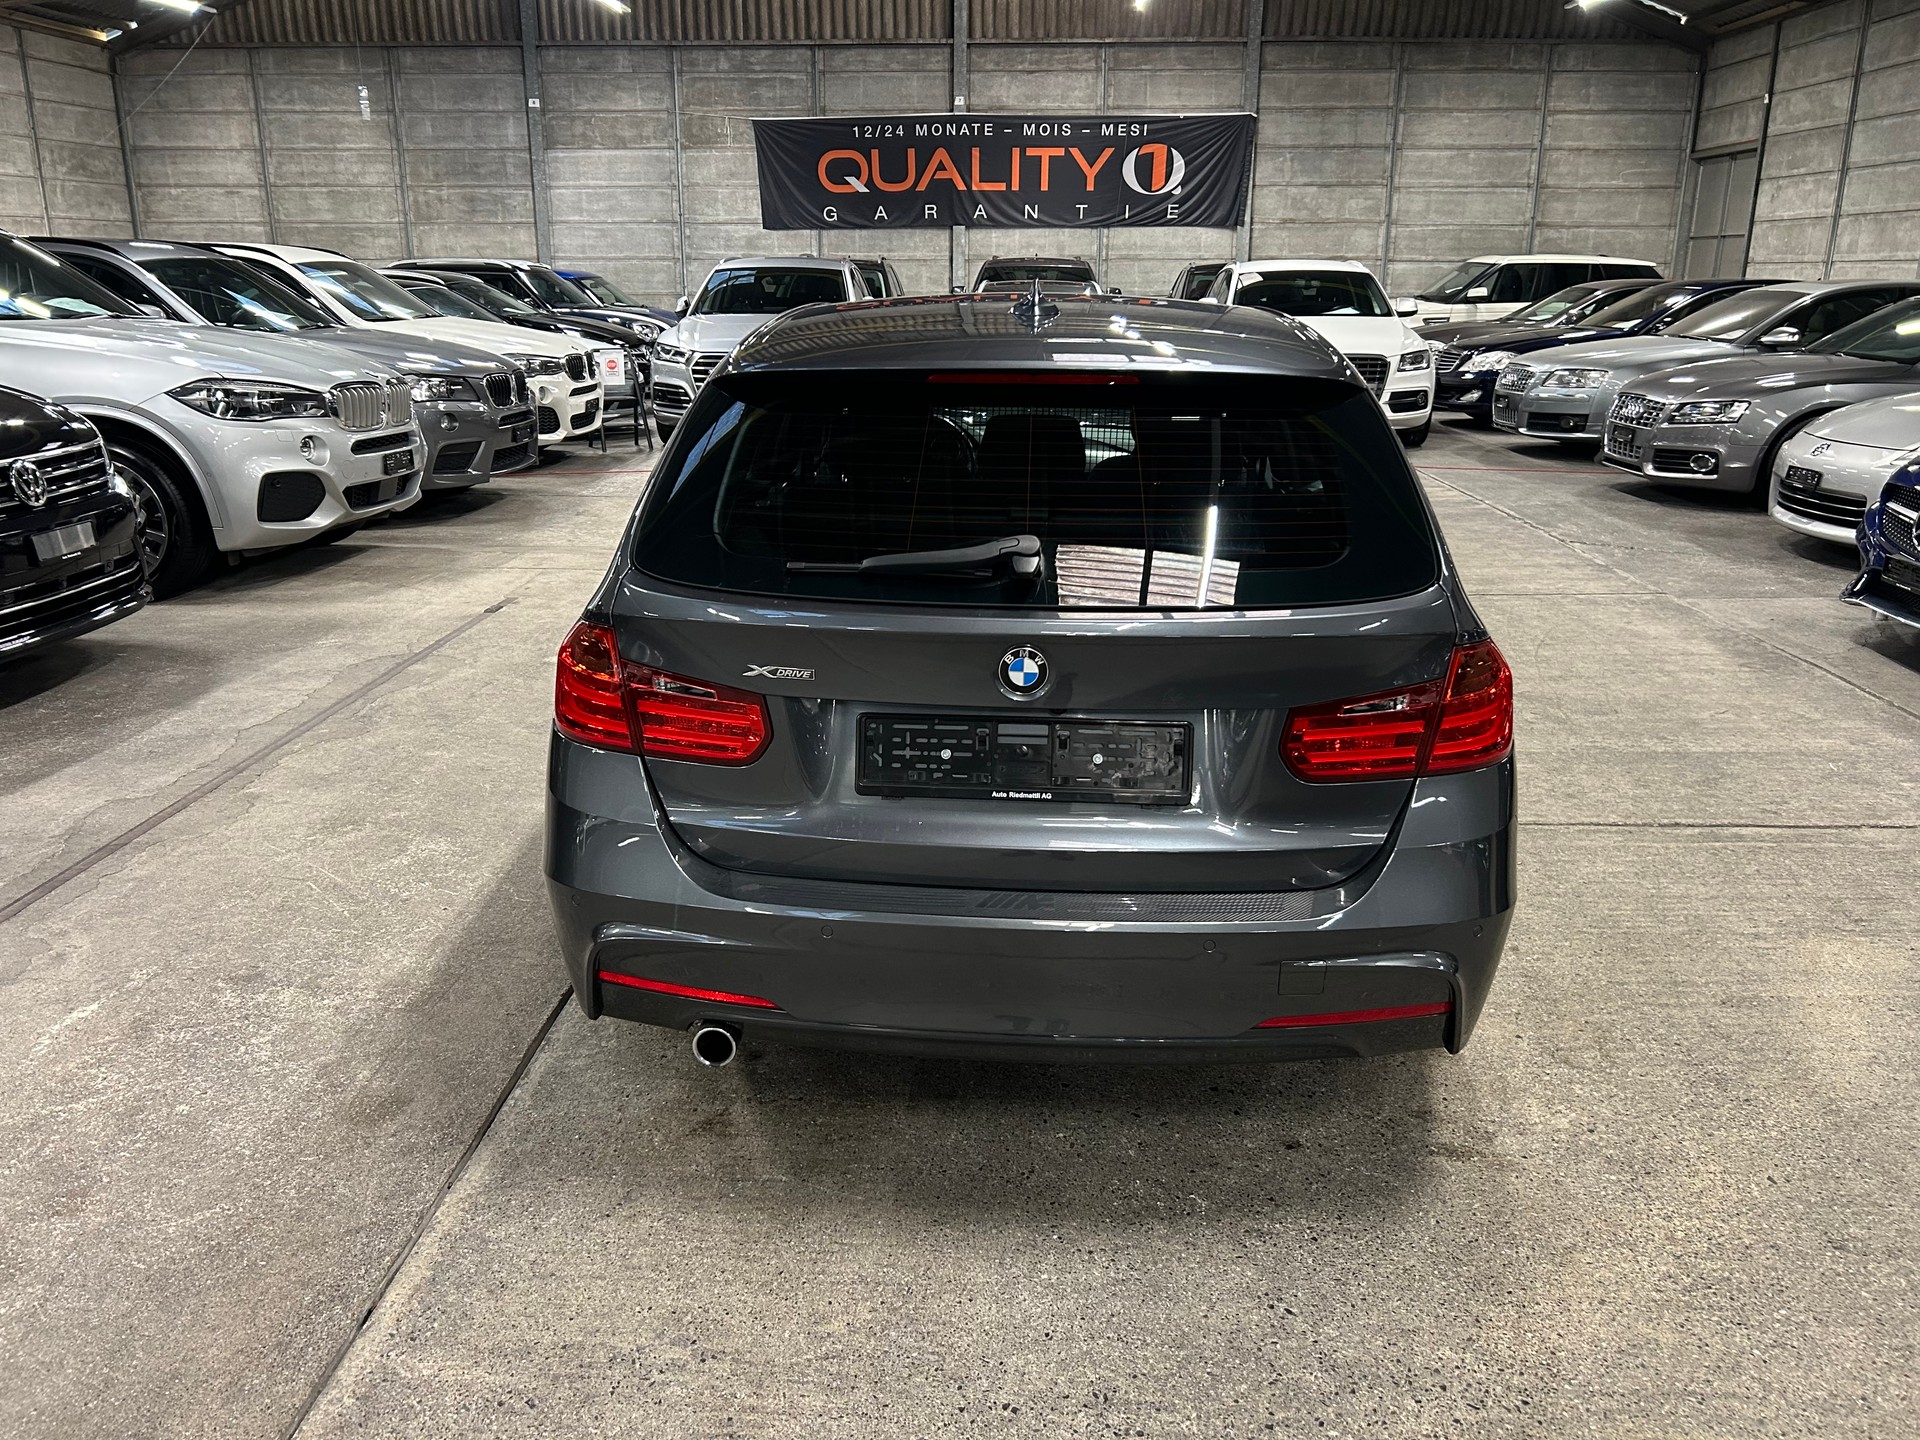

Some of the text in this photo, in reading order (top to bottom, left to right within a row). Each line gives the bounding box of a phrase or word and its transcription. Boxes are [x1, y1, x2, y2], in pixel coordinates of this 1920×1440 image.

[852, 124, 905, 138] 12/24
[915, 122, 994, 136] MONATE
[1023, 123, 1072, 136] MOIS
[1101, 122, 1149, 136] MESI
[817, 147, 1115, 193] QUALITY
[823, 203, 1180, 222] GARANTIE
[1004, 649, 1045, 665] BMW
